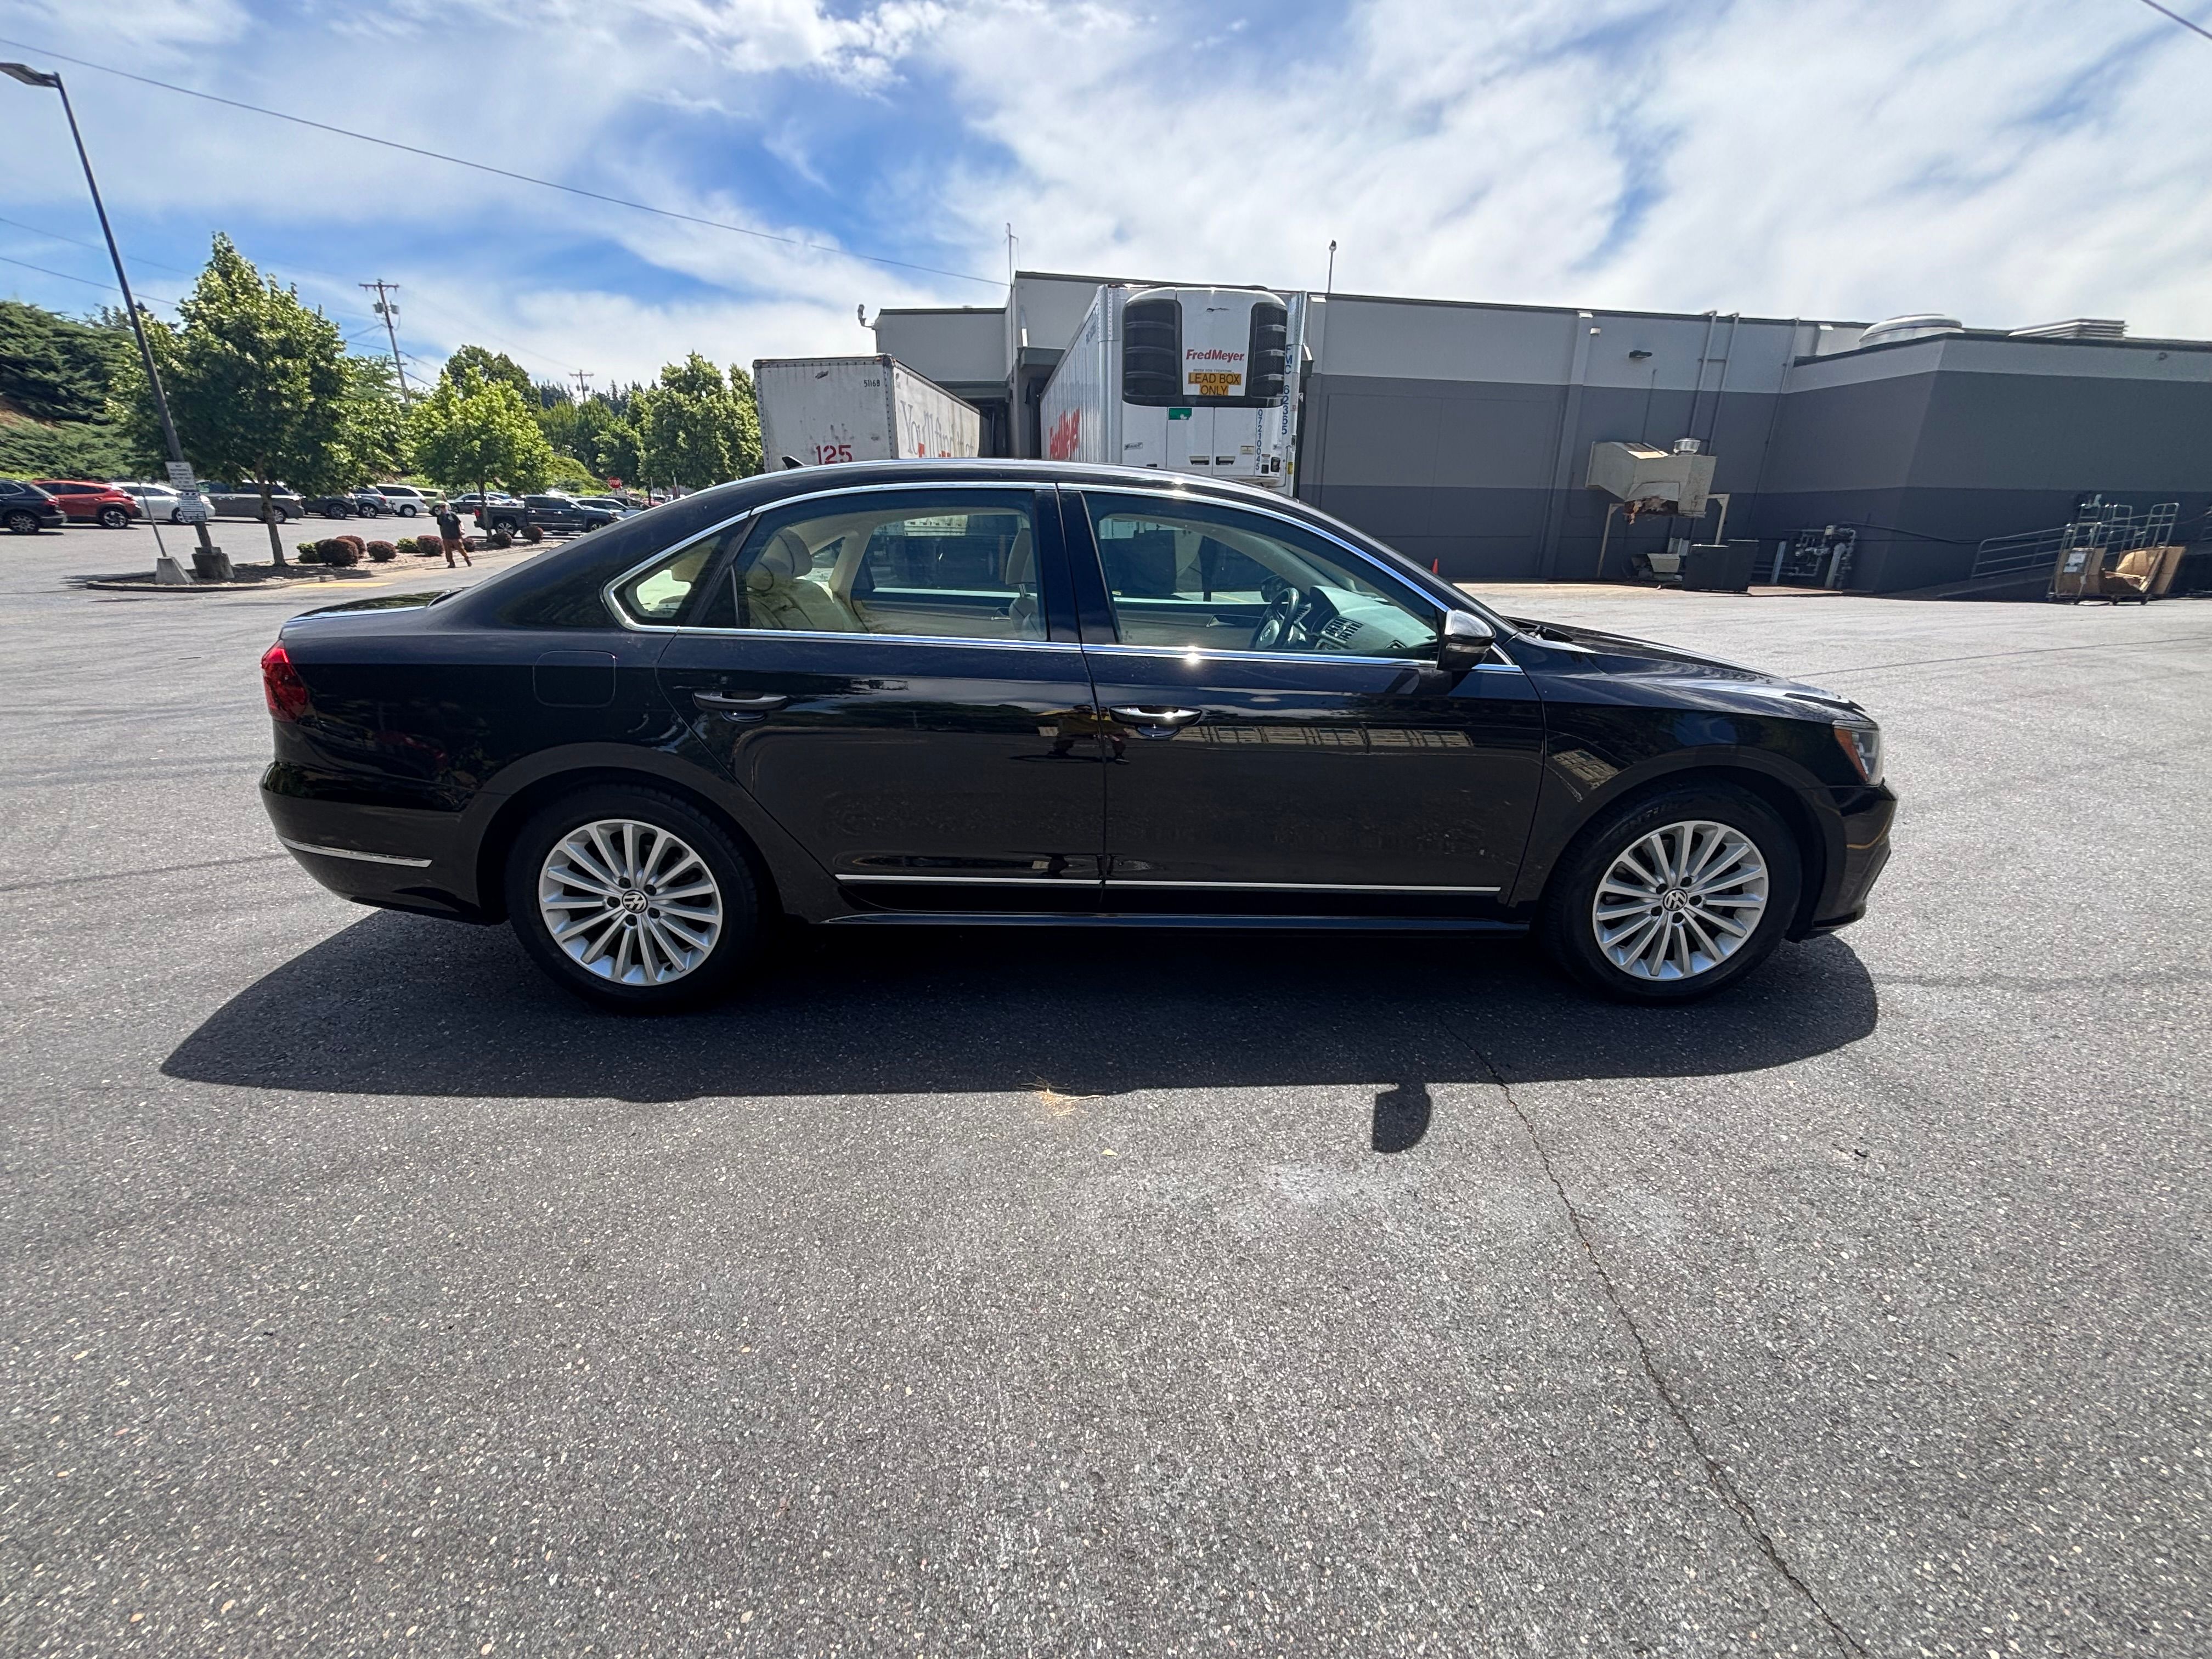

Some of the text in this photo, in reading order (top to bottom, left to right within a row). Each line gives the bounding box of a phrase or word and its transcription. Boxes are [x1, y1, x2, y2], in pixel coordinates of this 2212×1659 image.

[1186, 349, 1244, 363] FredMeyer
[1189, 373, 1240, 384] LEAD BOX
[1201, 386, 1228, 395] ONLY
[1281, 345, 1293, 435] FMC 62365
[816, 445, 853, 465] 125
